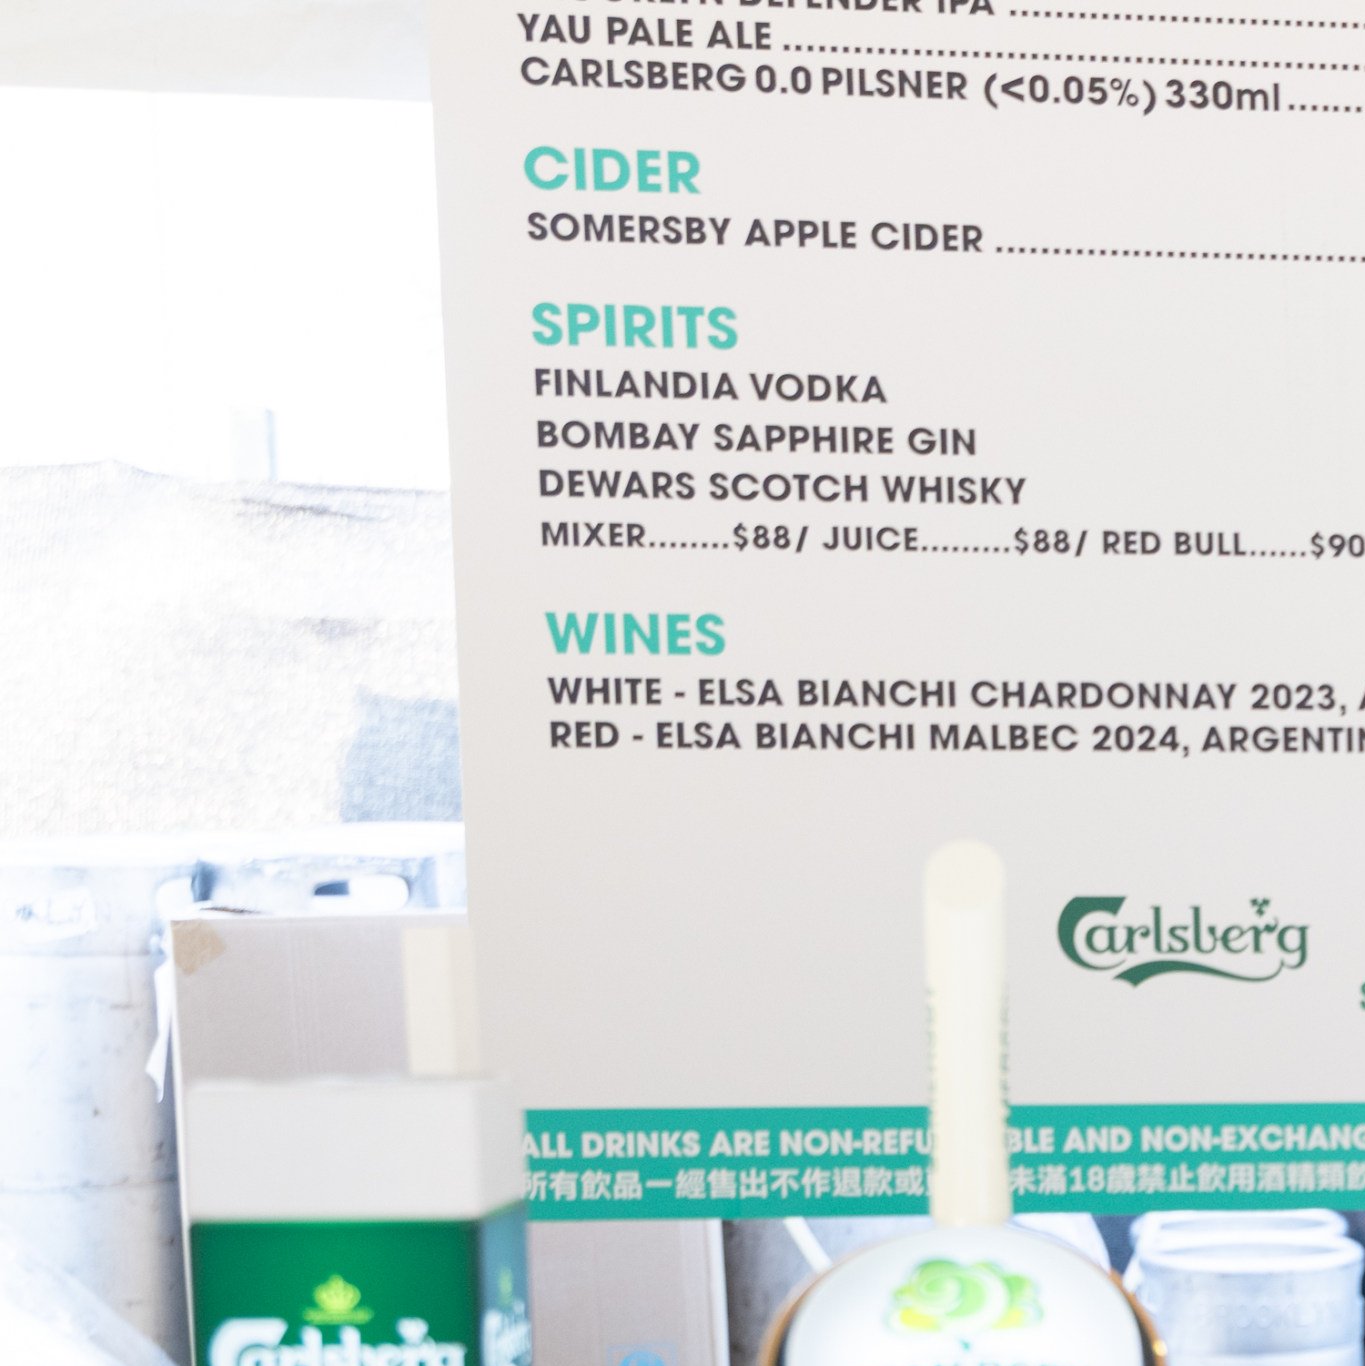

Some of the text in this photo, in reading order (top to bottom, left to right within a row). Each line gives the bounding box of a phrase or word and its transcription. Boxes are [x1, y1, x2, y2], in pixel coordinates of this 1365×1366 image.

[517, 13, 591, 44] YAU
[607, 16, 693, 47] PALE
[707, 20, 771, 50] ALE
[521, 56, 746, 92] CARLSBERG
[755, 65, 812, 95] 0.0
[822, 67, 967, 100] PILSNER
[983, 73, 1157, 115] (<0.05%)
[1166, 79, 1279, 111] 330ml
[524, 146, 700, 194] CIDER
[528, 212, 731, 245] SOMERSBY
[745, 219, 856, 249] APPLE
[871, 222, 982, 252] CIDER
[532, 302, 738, 350] SPIRITS
[535, 368, 887, 403] FINLANDIA VODKA
[537, 420, 975, 455] BOMBAY SAPPHIRE GIN
[539, 469, 1026, 505] DEWARS SCOTCH WHISKY
[1103, 530, 1161, 555] RED
[545, 612, 725, 656] WINES
[547, 677, 661, 705] WHITE
[699, 679, 783, 706] ELSA
[798, 679, 956, 707] BIANCHI
[971, 680, 1237, 710] CHARDONNAY
[1251, 683, 1346, 716] 2023,
[550, 721, 619, 748] RED
[657, 721, 741, 749] ELSA
[756, 723, 914, 750] BIANCHI
[930, 724, 1078, 751] MALBEC
[1093, 725, 1189, 757] 2024,
[1057, 895, 1310, 986] Carlsberg
[523, 1125, 1133, 1160] ALL DRINKS ARE AND
